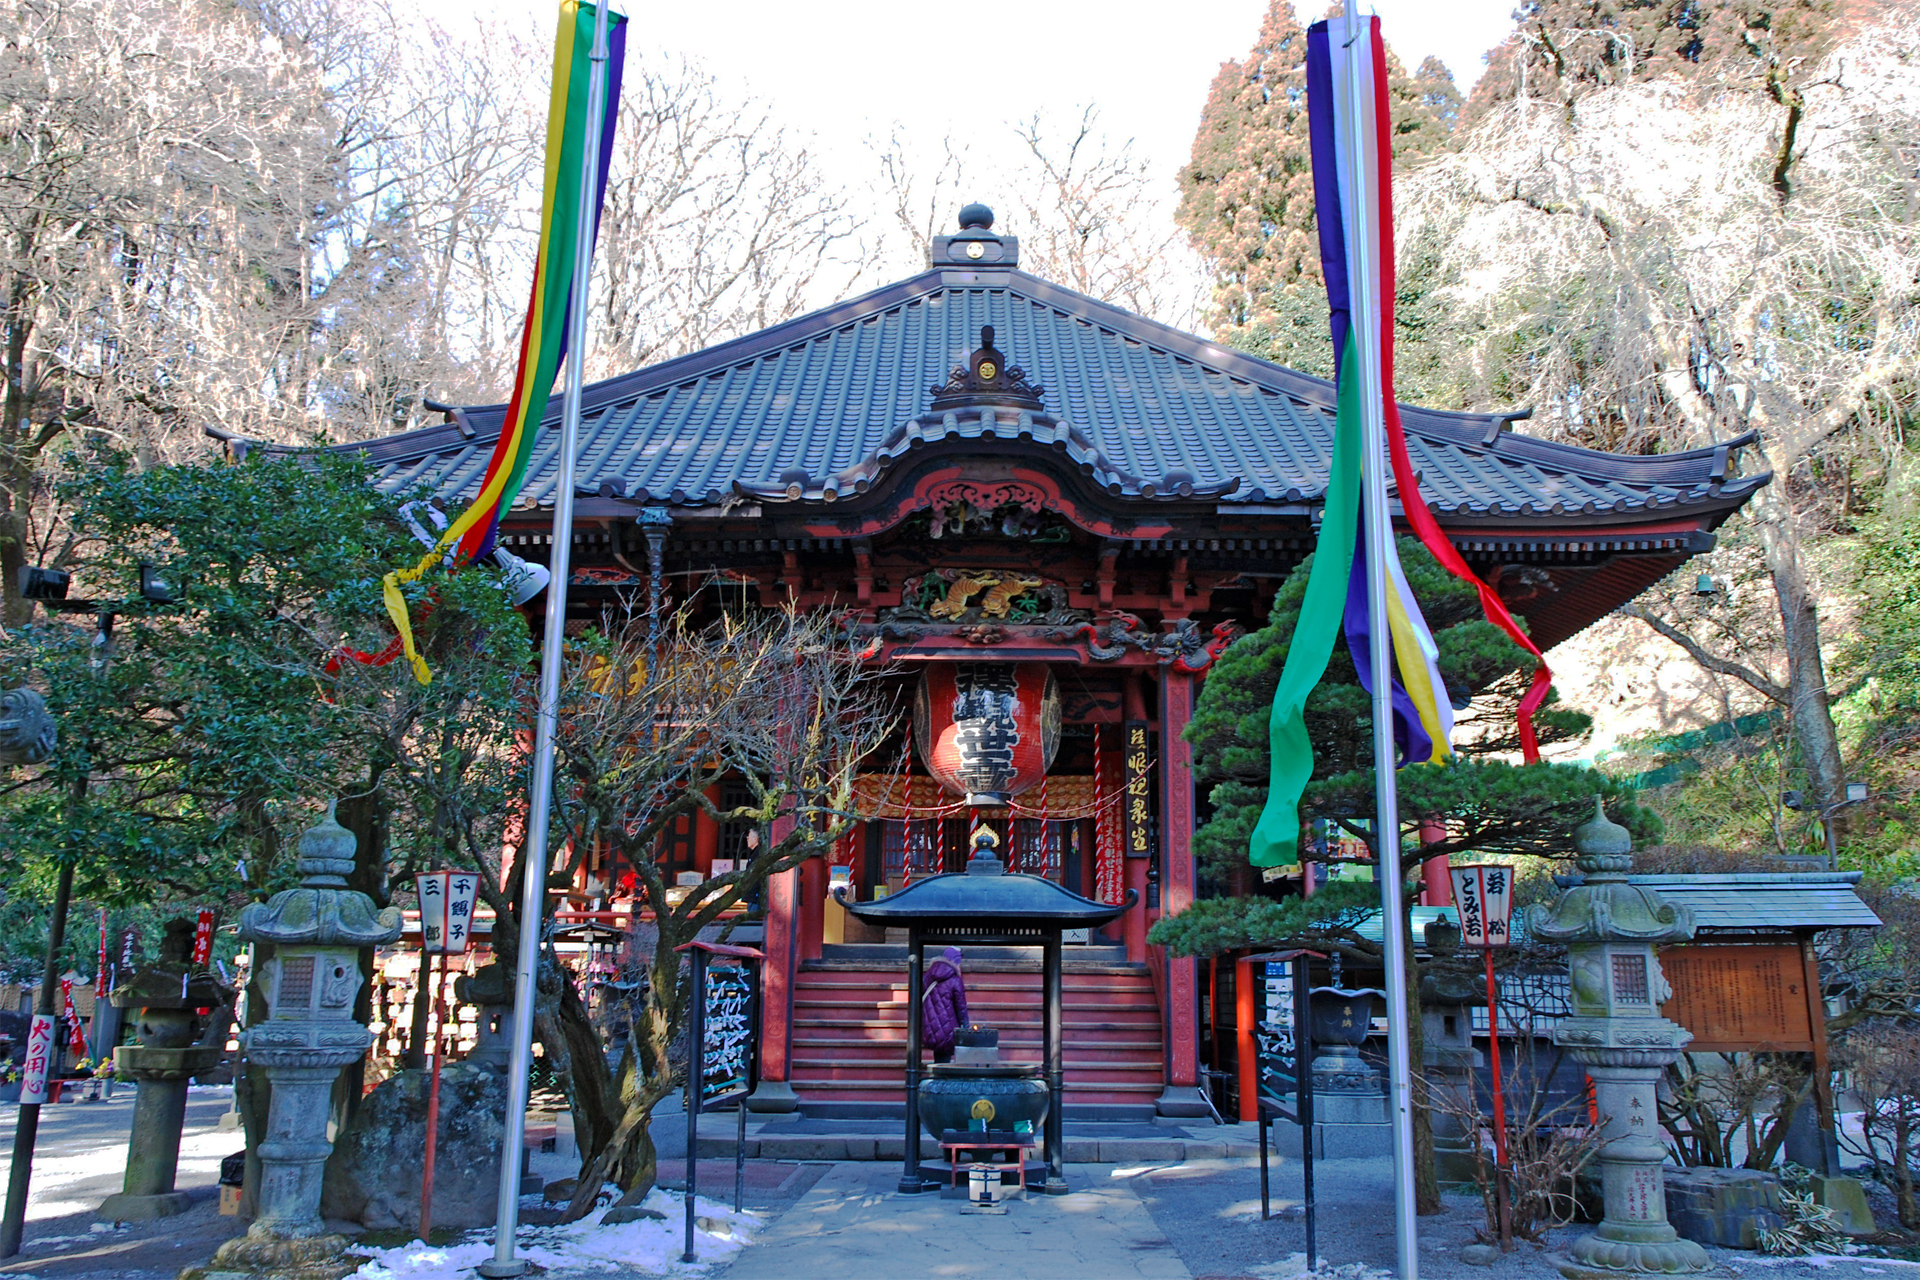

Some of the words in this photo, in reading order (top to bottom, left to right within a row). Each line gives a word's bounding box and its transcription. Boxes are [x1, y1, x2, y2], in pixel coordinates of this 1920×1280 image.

[450, 878, 471, 940] 千鶴子
[21, 1019, 51, 1094] 火の用心
